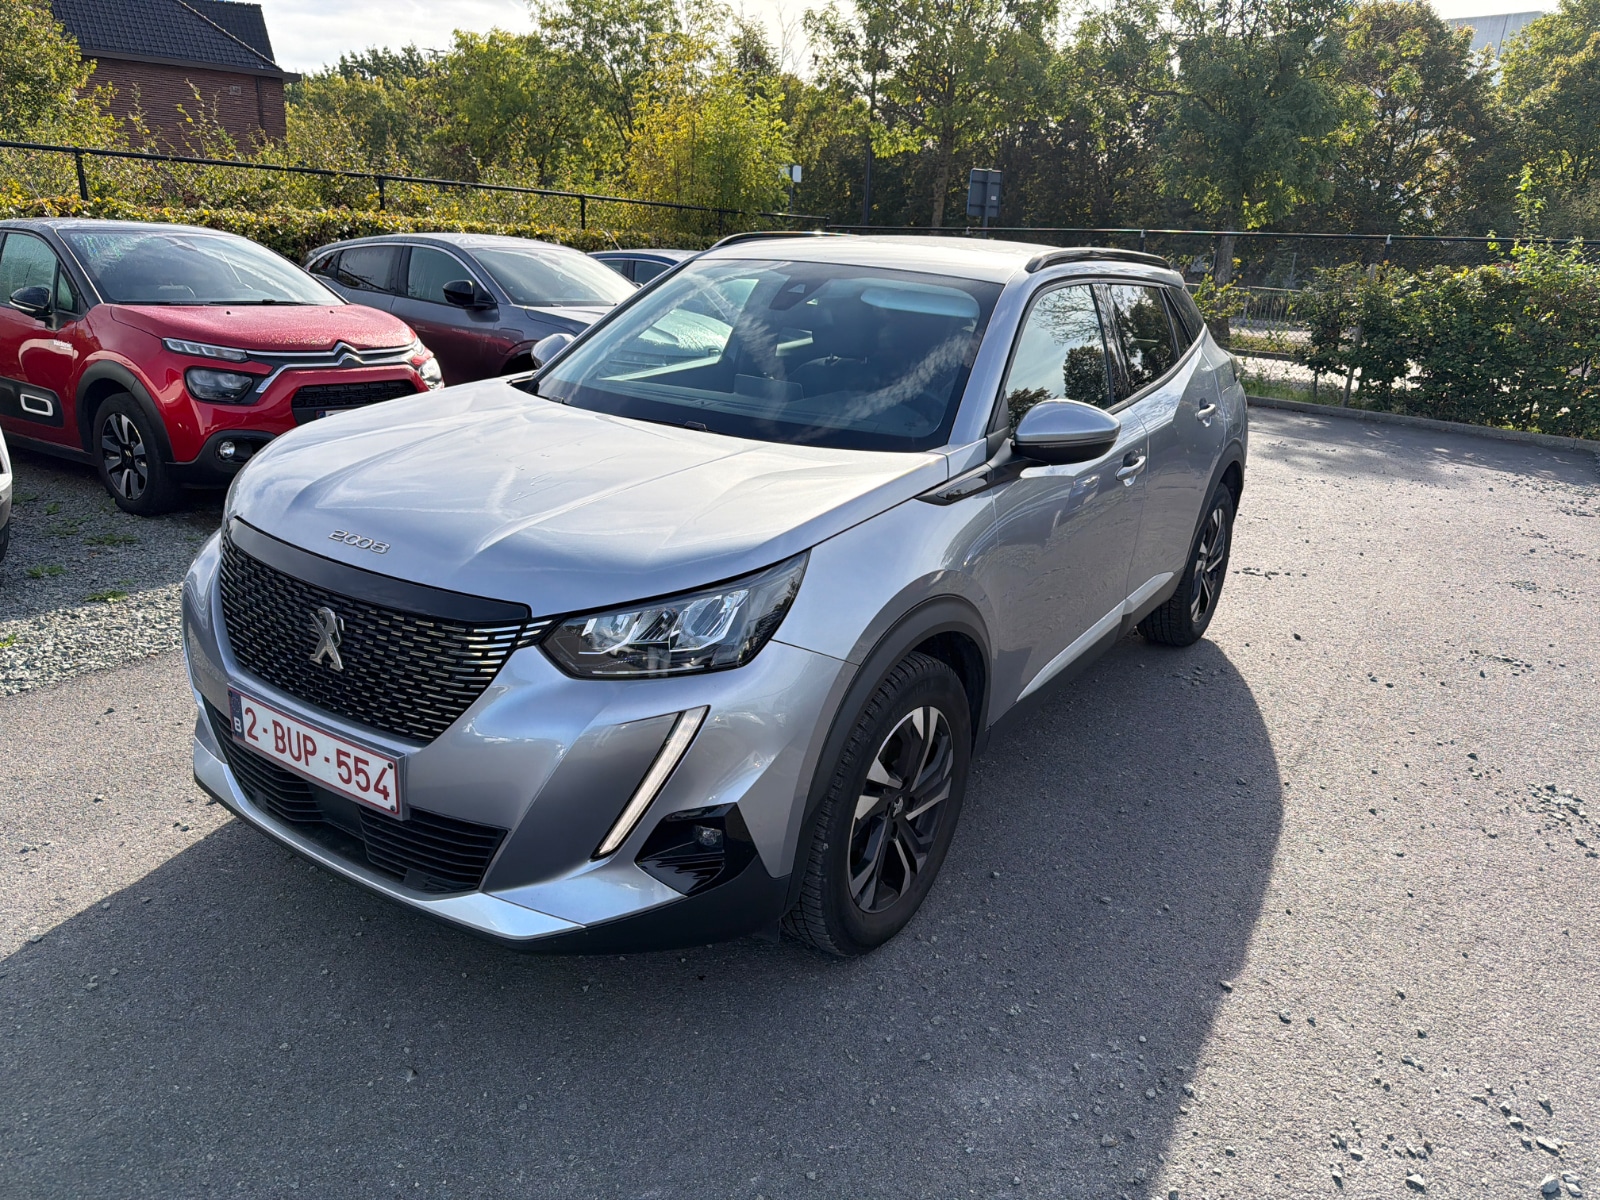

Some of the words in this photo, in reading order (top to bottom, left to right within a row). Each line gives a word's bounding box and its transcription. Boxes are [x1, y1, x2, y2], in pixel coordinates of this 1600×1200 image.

[328, 529, 390, 554] 2008
[233, 716, 242, 733] B
[244, 706, 390, 801] 2-BUP-554
